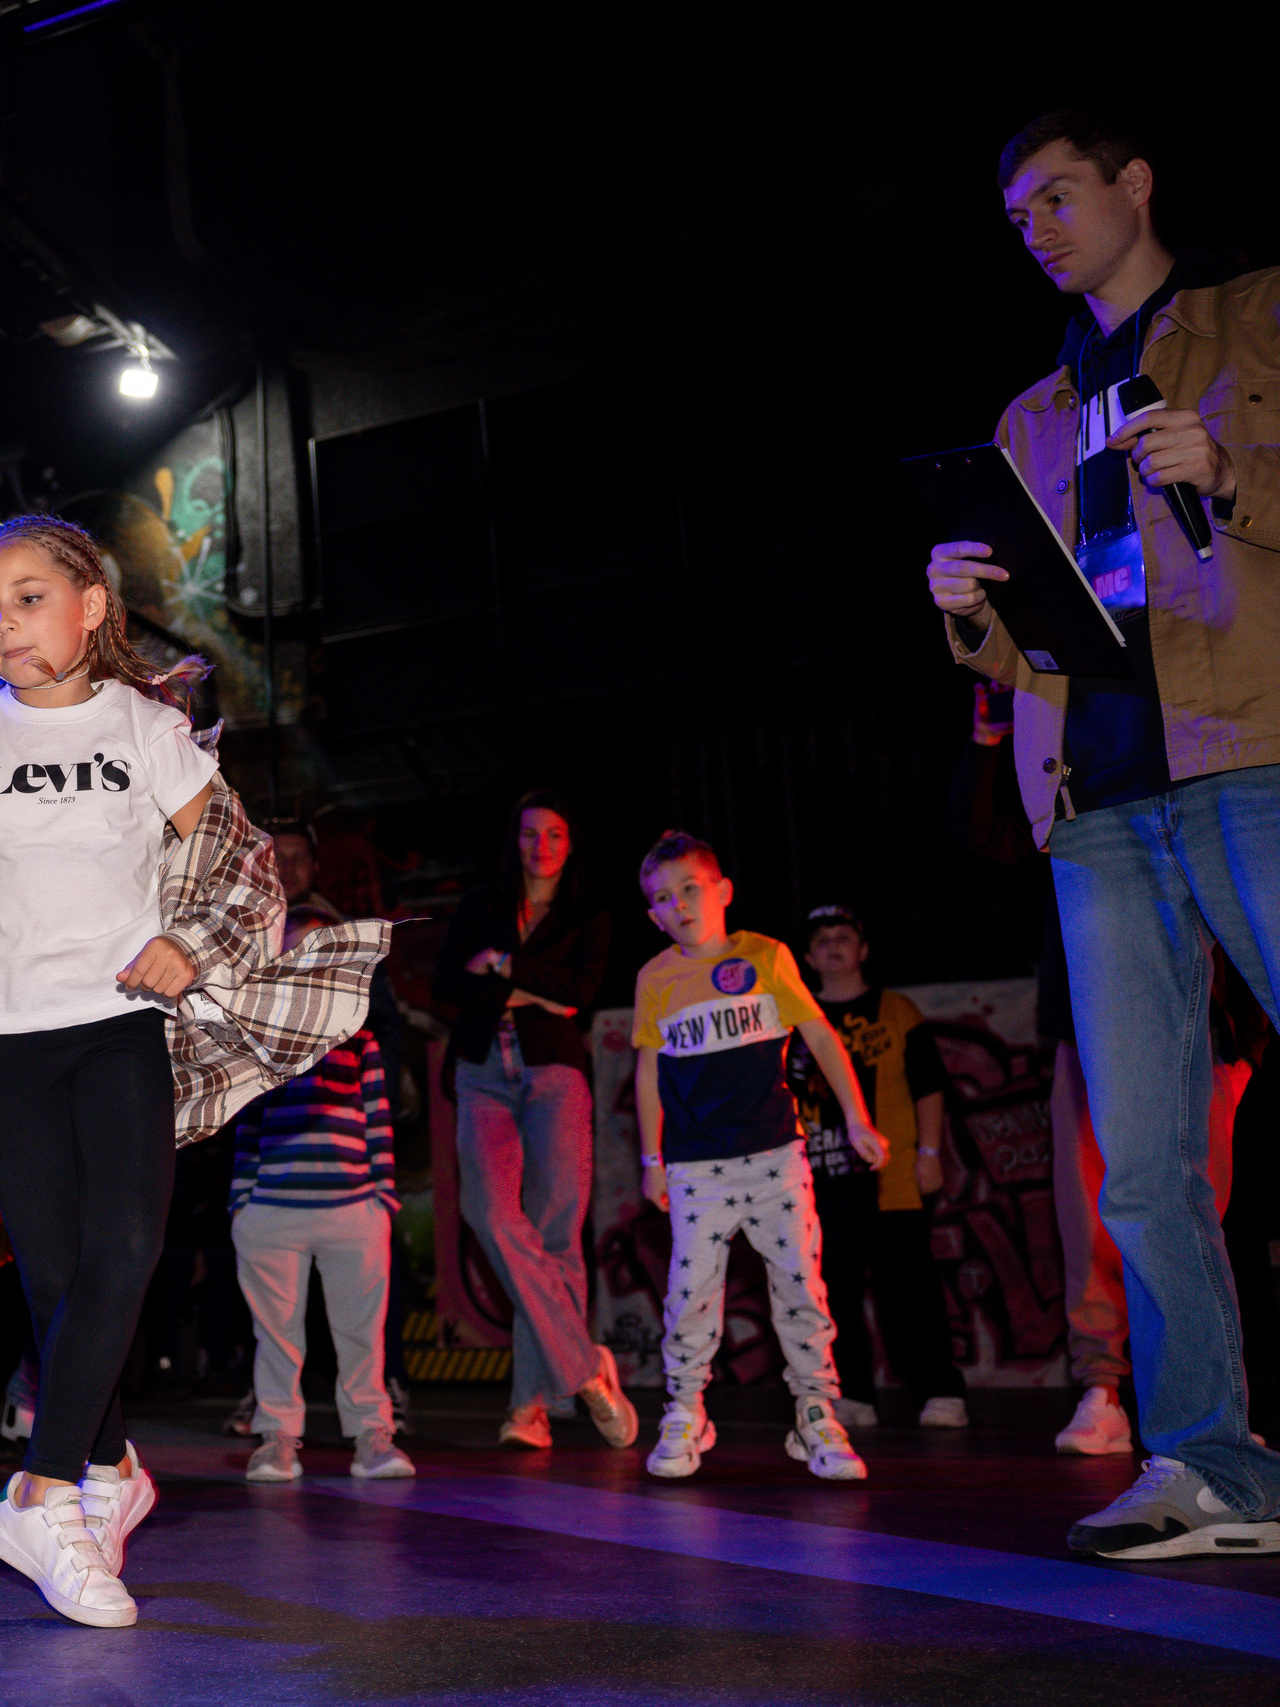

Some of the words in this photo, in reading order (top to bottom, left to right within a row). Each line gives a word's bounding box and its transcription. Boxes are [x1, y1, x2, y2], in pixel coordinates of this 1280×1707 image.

[1095, 567, 1129, 599] MC
[38, 796, 58, 805] Since
[60, 796, 76, 805] 1873
[667, 1015, 705, 1050] NEW
[710, 1003, 763, 1040] YORK
